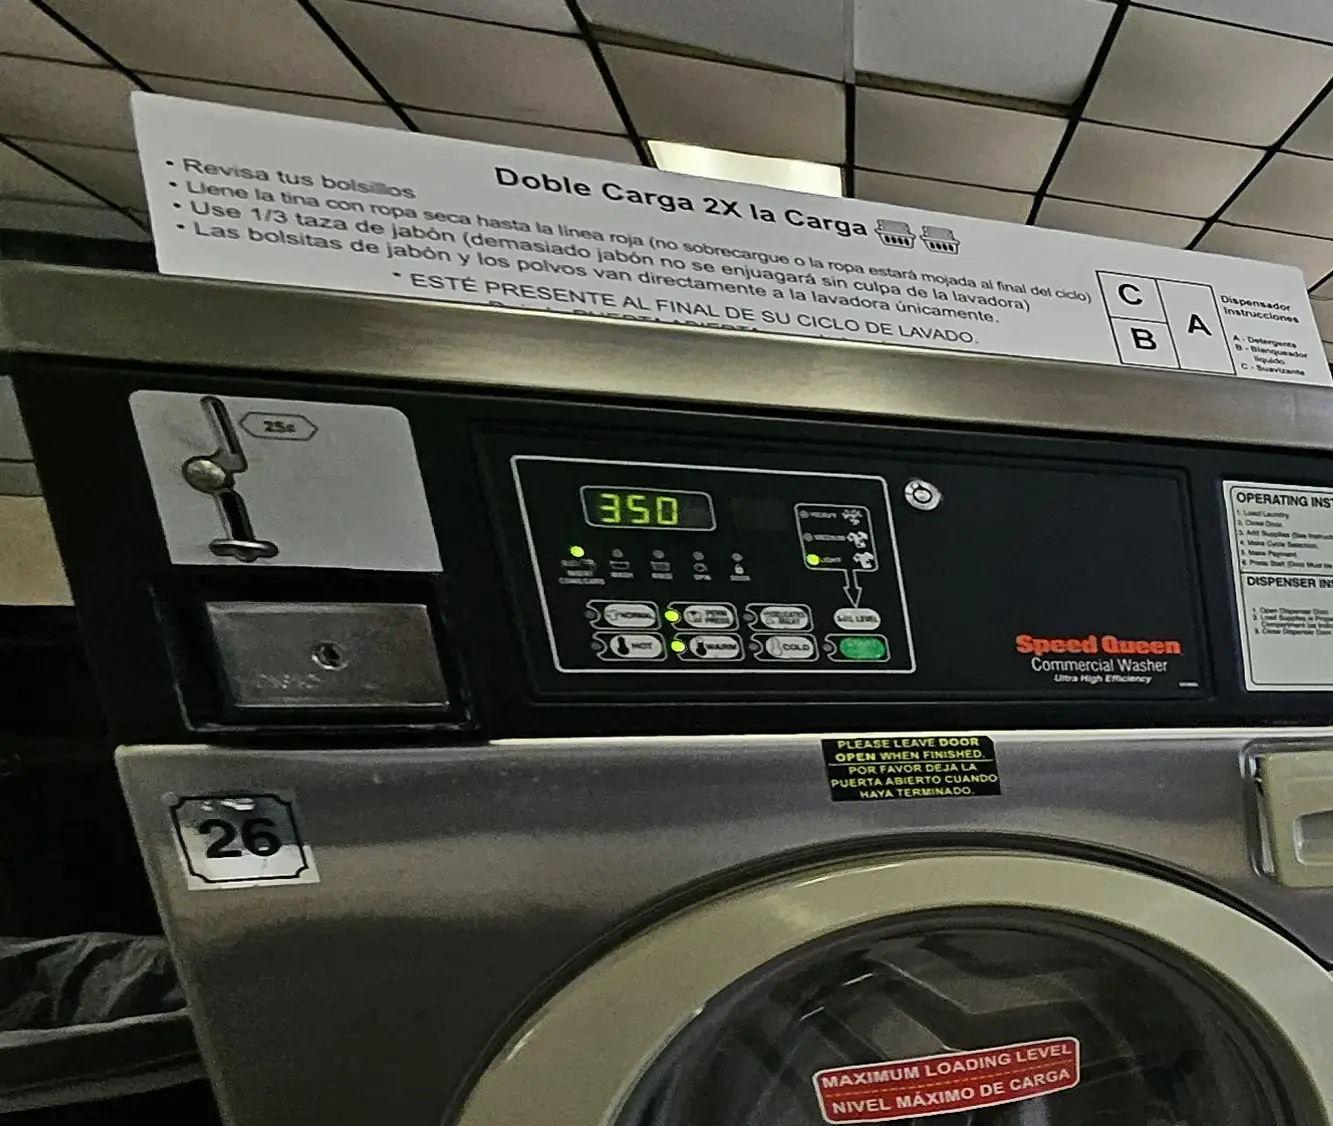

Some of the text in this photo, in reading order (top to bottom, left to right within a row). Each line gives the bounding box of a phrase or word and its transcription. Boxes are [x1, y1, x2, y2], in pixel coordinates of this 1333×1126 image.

[183, 157, 416, 200] Revisa tus bolsillos
[494, 166, 868, 237] Doble Carga 2X la Carga
[186, 180, 248, 200] Llene
[254, 188, 274, 203] la
[281, 191, 320, 208] tina
[325, 197, 364, 213] con
[370, 204, 418, 221] ropa
[423, 210, 471, 226] seca
[476, 214, 530, 233] hasta
[535, 221, 554, 236] la
[609, 233, 644, 248] roja
[649, 235, 678, 251] (no
[683, 241, 790, 266] sobrecargue
[794, 257, 806, 267] o
[808, 257, 825, 270] la
[828, 261, 865, 276] ropa
[869, 266, 917, 281] estará
[921, 272, 977, 288] mojada
[980, 278, 994, 291] al
[996, 280, 1028, 295] final
[1030, 285, 1052, 298] del
[1055, 289, 1092, 304] ciclo)
[190, 201, 1031, 313] Use 1/3 taza de jabón (demasiado jabón no se enjuagará sin culpa de la lavadora)
[193, 220, 241, 240] Las
[247, 228, 343, 251] bolsitas
[350, 239, 380, 254] de
[386, 242, 451, 262] jabón
[457, 254, 477, 268] y
[478, 253, 511, 269] los
[517, 259, 588, 279] polvos
[592, 267, 633, 282] van
[637, 270, 767, 298] directamente
[772, 288, 784, 299] a
[789, 287, 807, 301] la
[811, 290, 891, 311] lavadora
[895, 299, 999, 324] únicamente.
[1117, 283, 1144, 306] C
[1220, 295, 1292, 312] Dispensador
[410, 272, 980, 345] ESTÉ PRESENTE AL FINAL DE SU CICLO DE LAVADO.
[1223, 306, 1300, 324] Instrucciones
[1187, 314, 1213, 337] A
[1130, 327, 1157, 350] B
[601, 493, 679, 525] 350
[1236, 492, 1308, 508] OPERATING
[1246, 577, 1316, 588] DISPENSER
[782, 643, 810, 651] COLD
[1015, 634, 1182, 656] Speed Queen
[1031, 656, 1168, 673] Commercial Washer
[1054, 674, 1152, 685] Ultra High Efficiency
[837, 737, 980, 750] PLEASE LEAVE DOOR
[834, 752, 876, 762] OPEN
[880, 751, 920, 760] WHEN
[848, 763, 978, 775] POR FAVOR DEJA LA
[831, 774, 998, 788] PUERTA ABIERTO CUANDO
[859, 788, 894, 799] HAYA
[197, 817, 282, 859] 26
[821, 1043, 1073, 1089] MAXIMUM LOADING LEVEL
[831, 1068, 1071, 1114] NIVEL MÁXIMO DE CARGA
